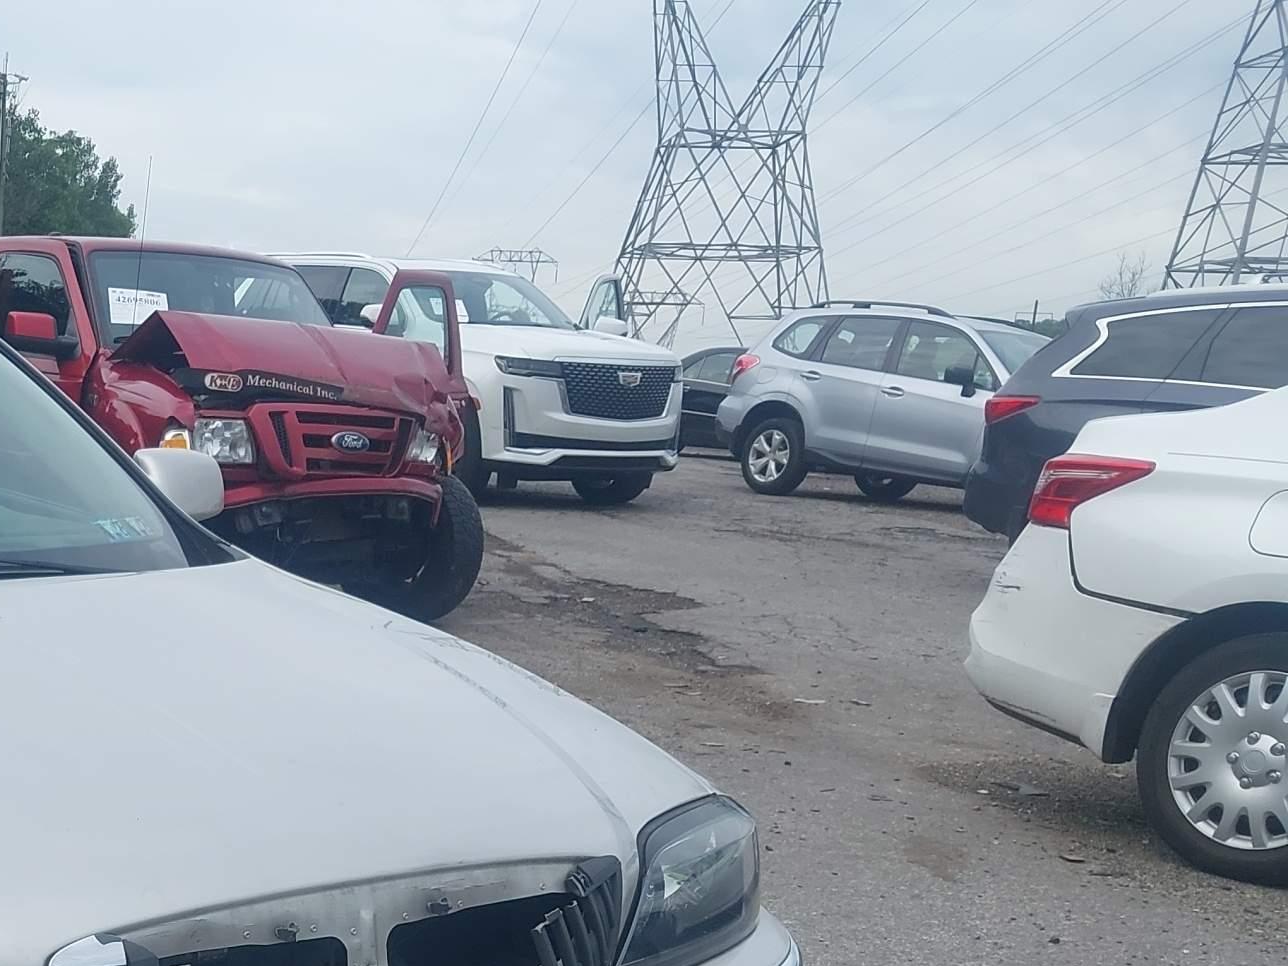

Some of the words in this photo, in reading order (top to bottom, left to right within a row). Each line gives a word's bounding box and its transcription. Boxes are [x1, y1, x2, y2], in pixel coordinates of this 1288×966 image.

[245, 374, 314, 396] Mechanical
[316, 386, 337, 400] Inc.
[342, 434, 364, 449] Ford
